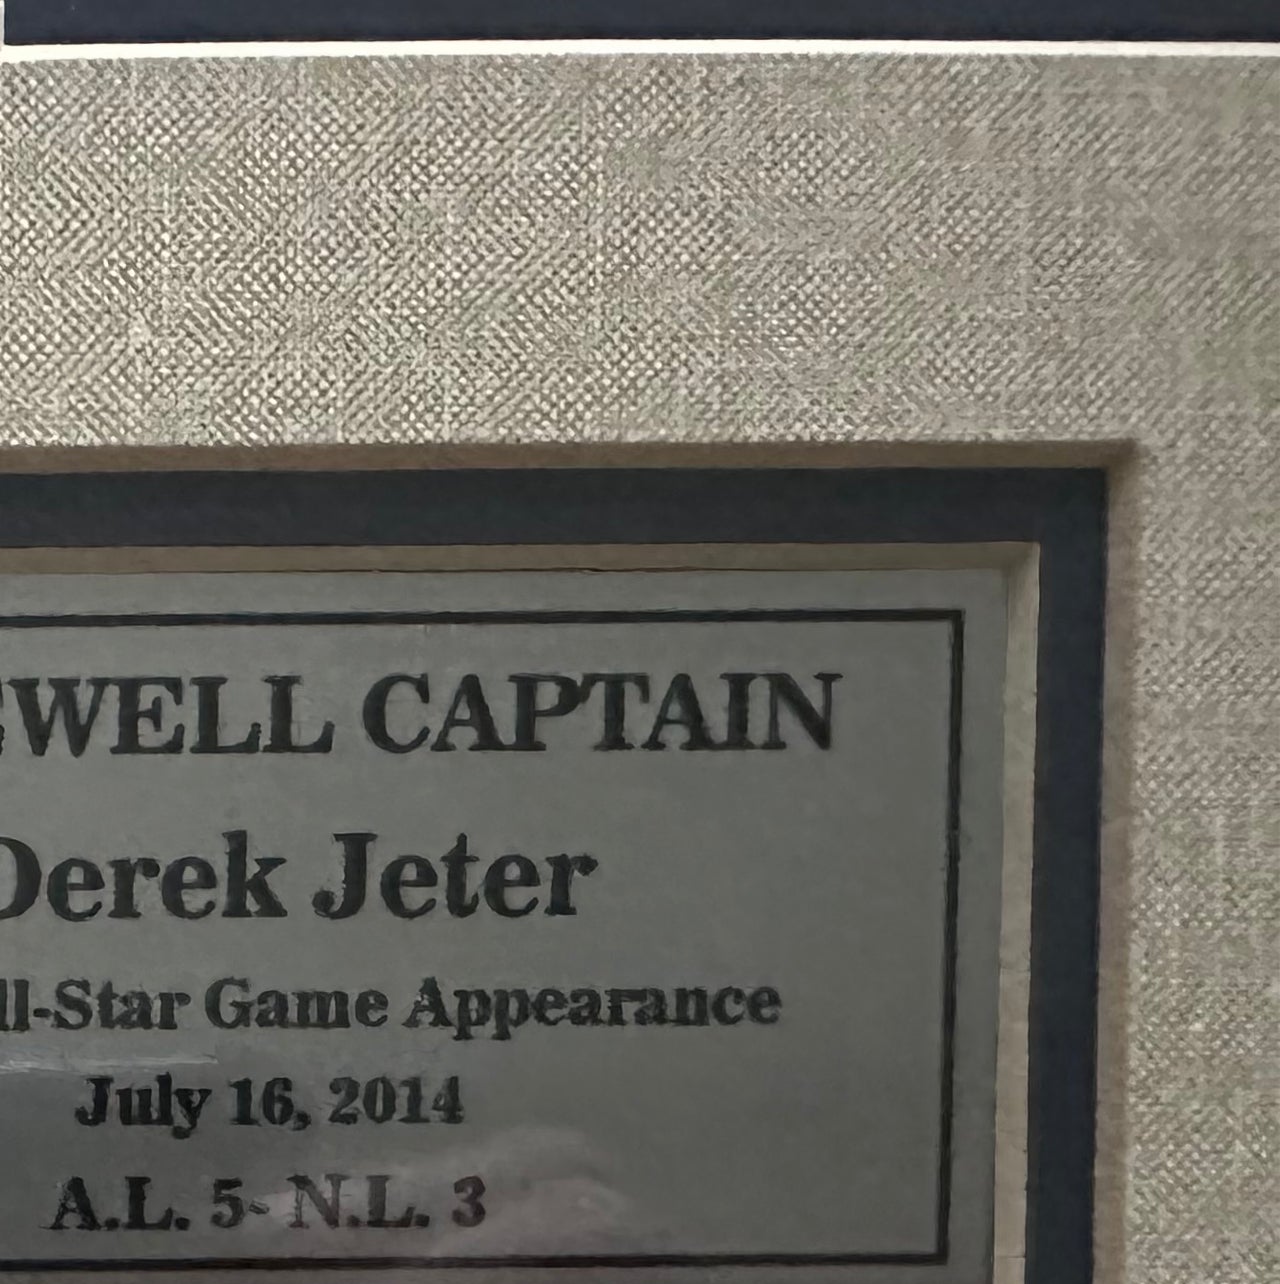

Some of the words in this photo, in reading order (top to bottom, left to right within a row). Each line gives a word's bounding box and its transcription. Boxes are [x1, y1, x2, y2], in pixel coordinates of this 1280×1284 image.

[362, 671, 842, 753] CAPTAIN
[312, 832, 598, 922] Jeter
[203, 978, 388, 1030] Game
[409, 977, 782, 1041] Appearance
[75, 1072, 212, 1139] July
[228, 1077, 311, 1130] 16,
[328, 1075, 466, 1125] 2014
[40, 1175, 190, 1231] A.L.
[287, 1174, 430, 1229] N.L.
[451, 1175, 487, 1228] 3
